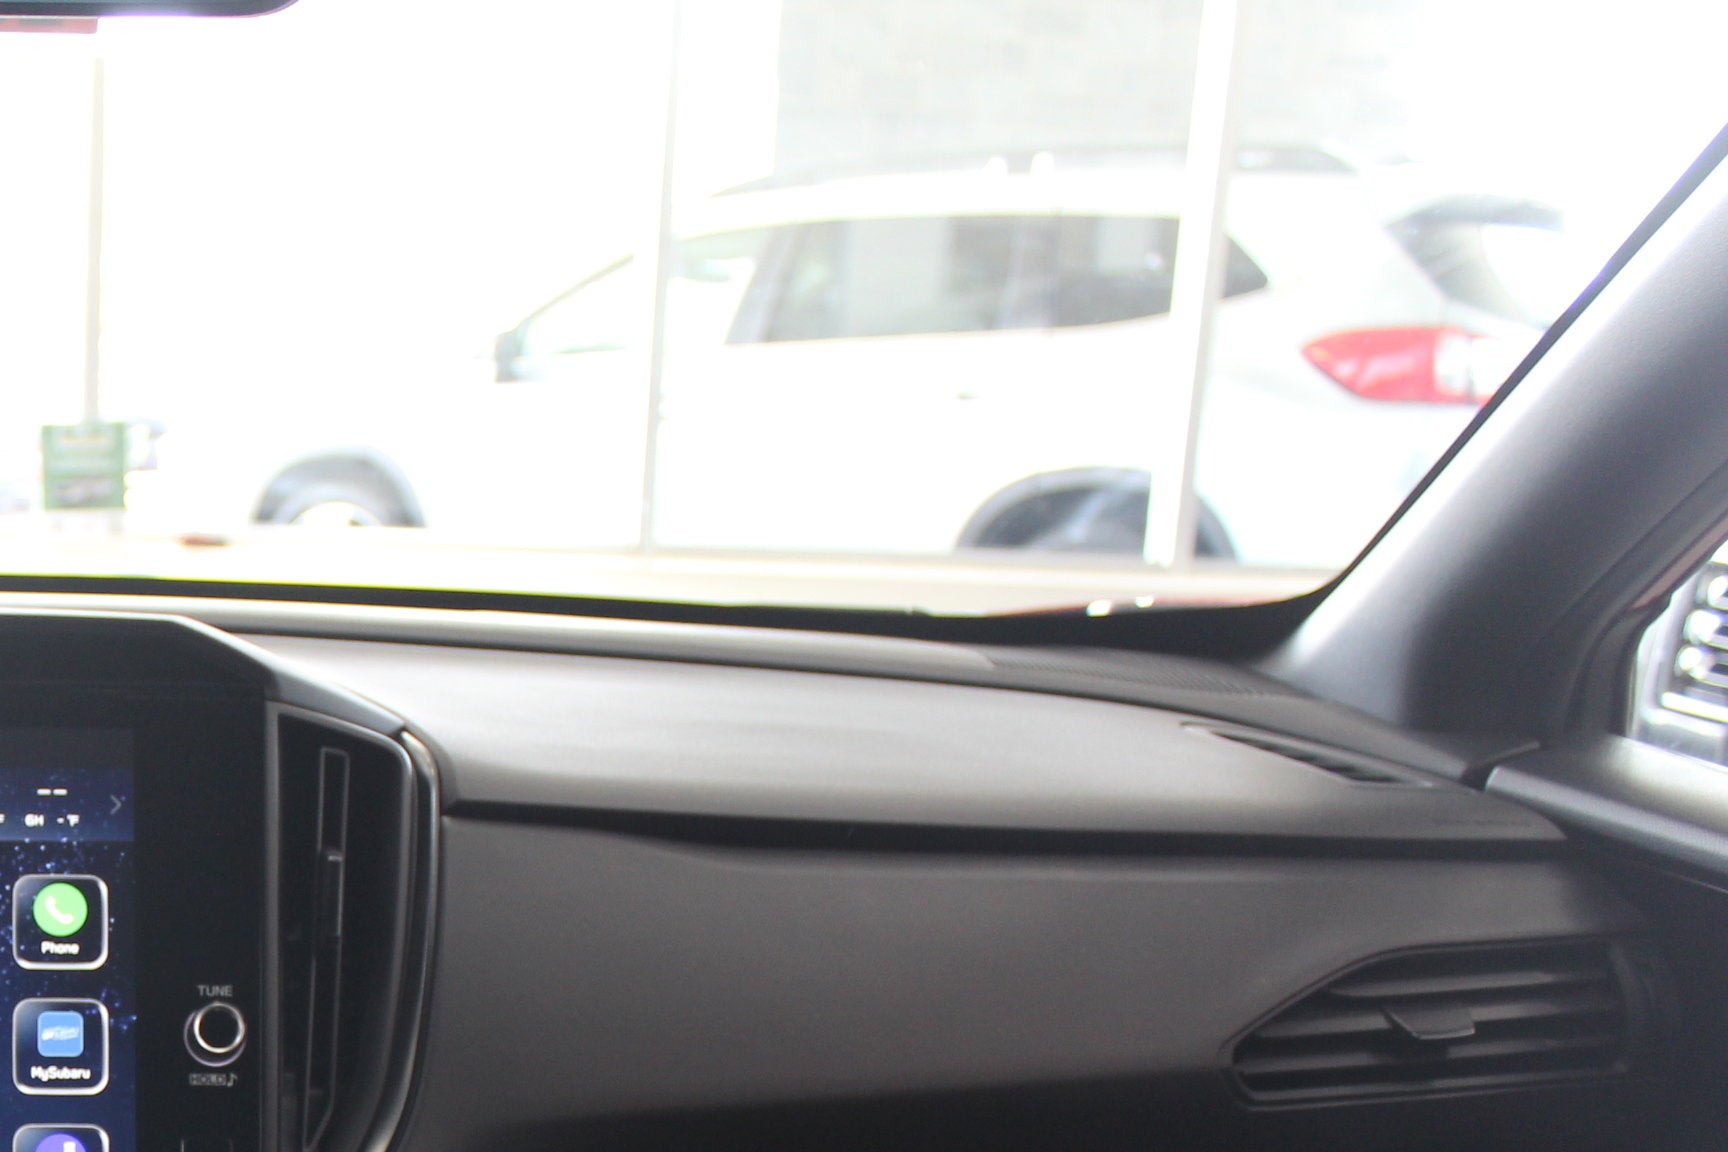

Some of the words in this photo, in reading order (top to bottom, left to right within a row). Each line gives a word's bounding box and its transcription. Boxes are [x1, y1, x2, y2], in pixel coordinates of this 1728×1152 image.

[24, 813, 44, 827] 6H
[41, 941, 80, 955] Phone
[197, 985, 233, 996] TUNE
[31, 1067, 90, 1081] MySubaru
